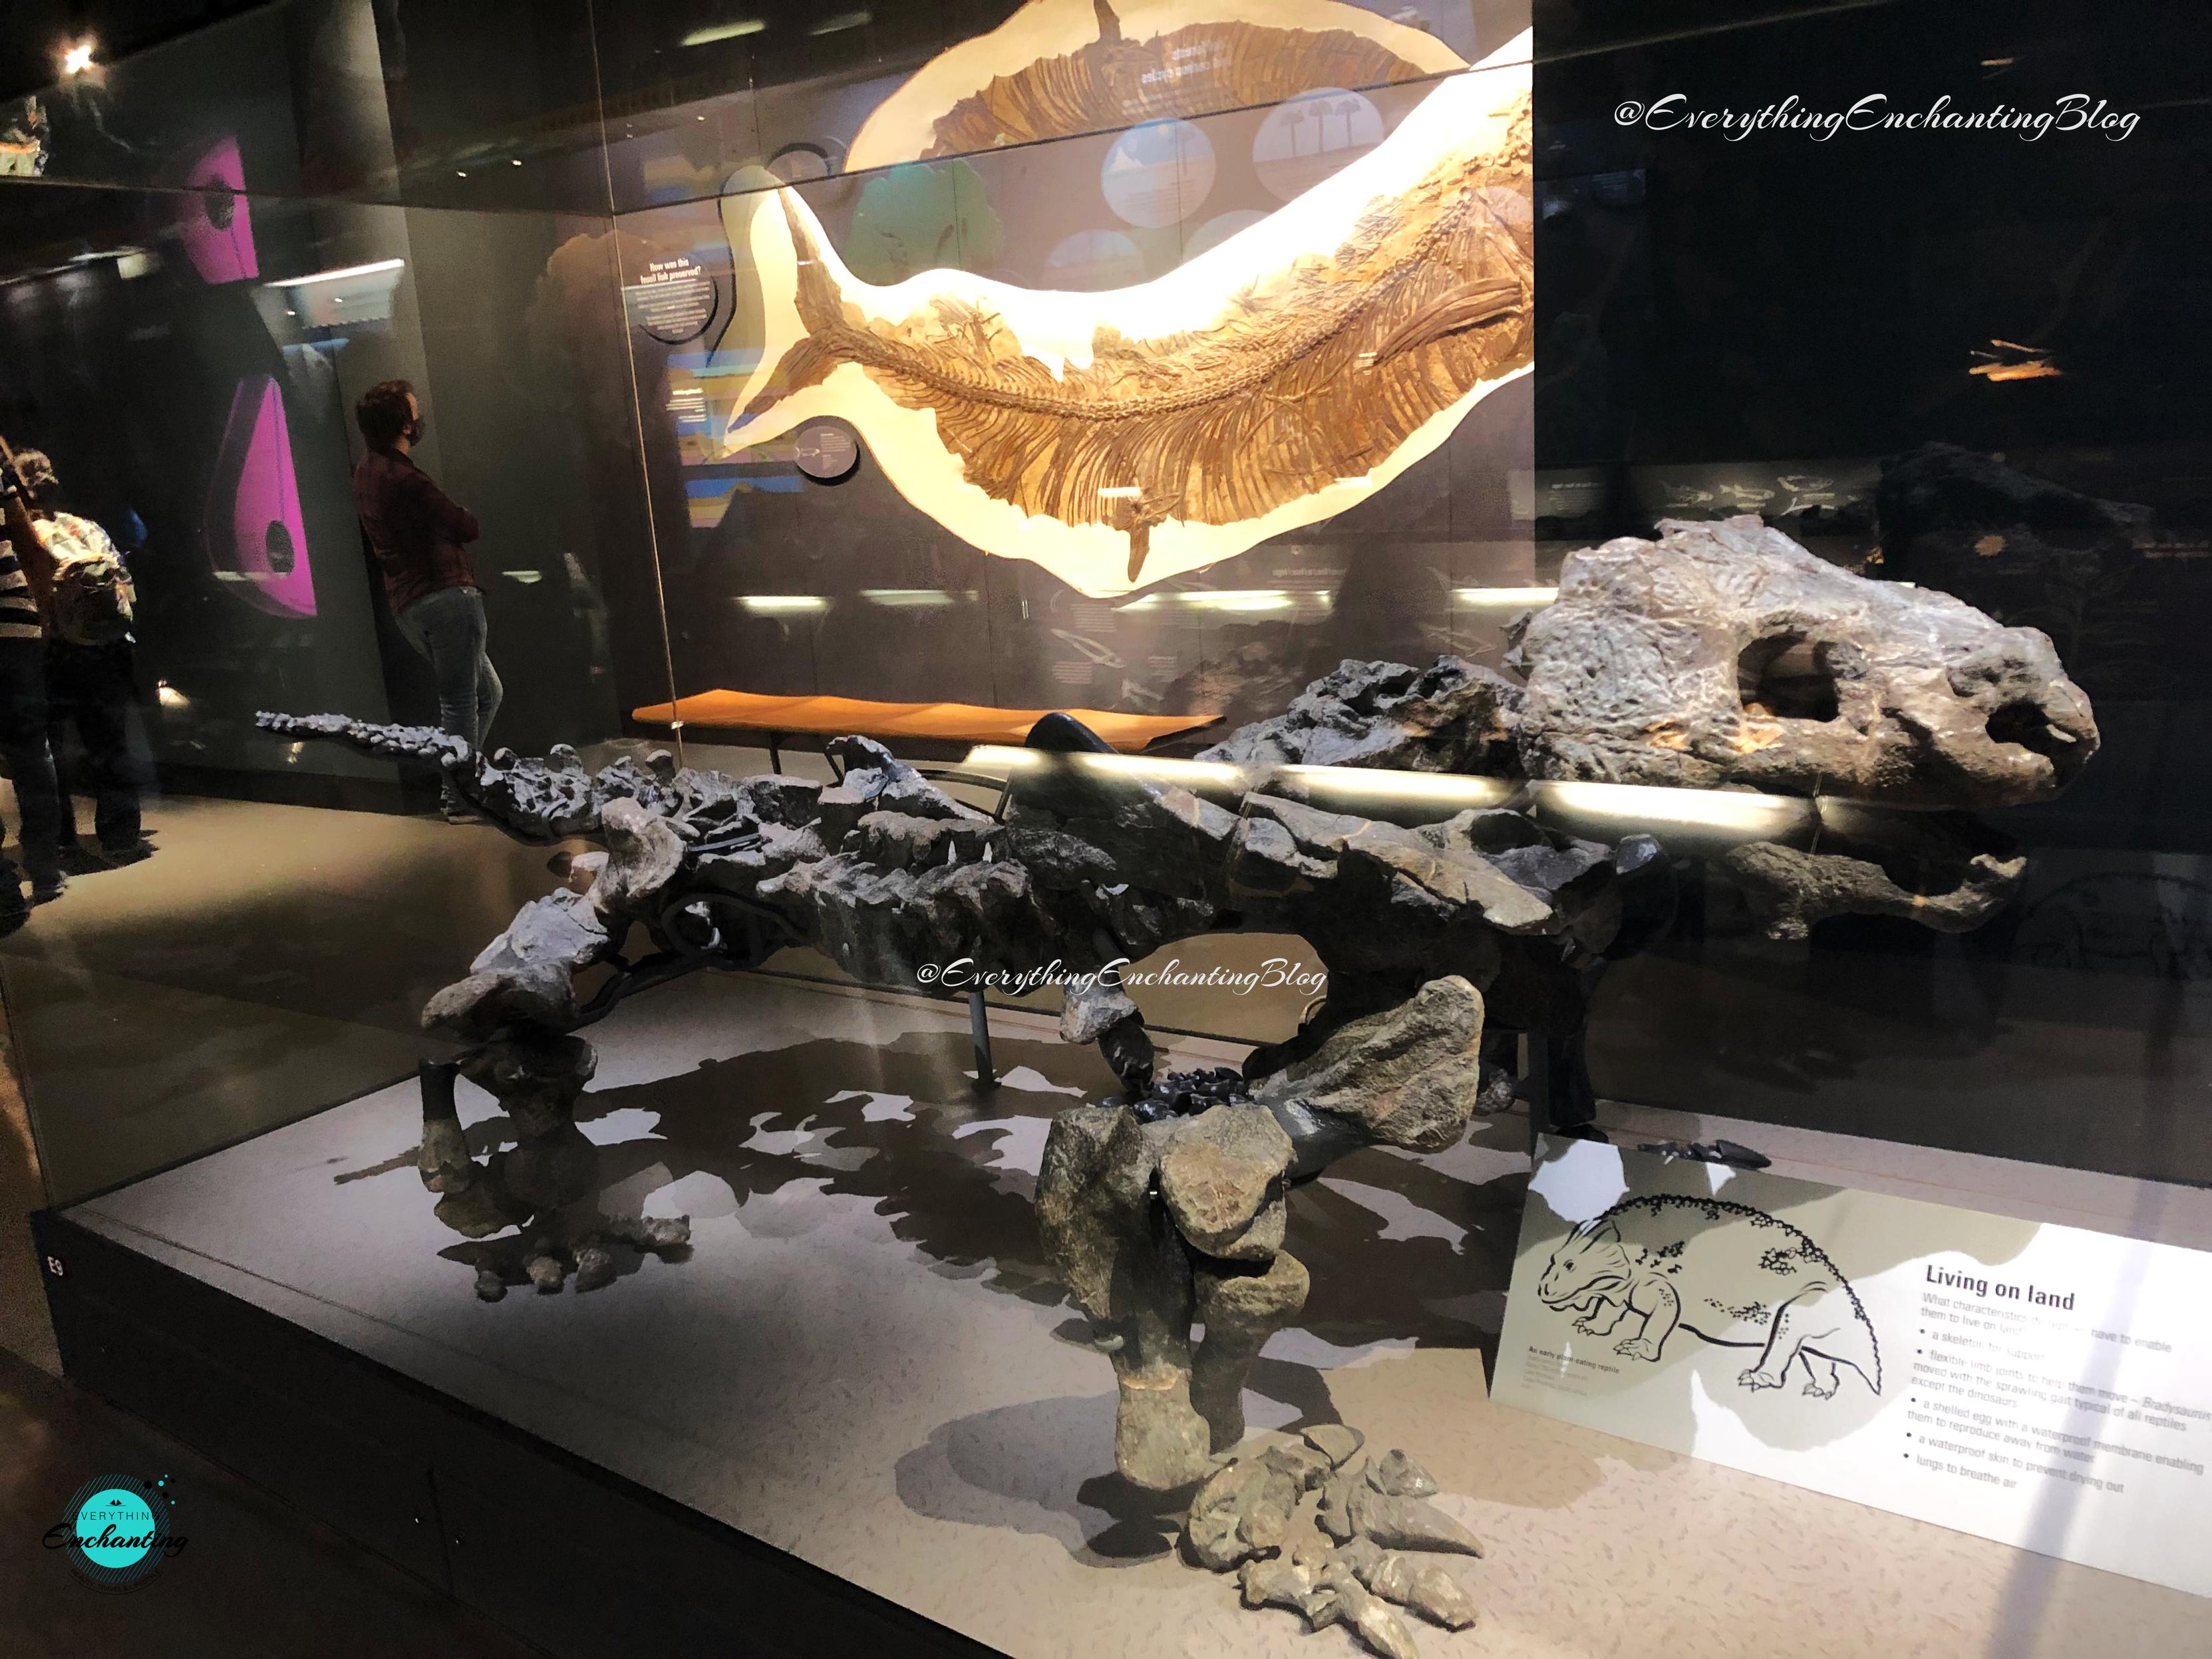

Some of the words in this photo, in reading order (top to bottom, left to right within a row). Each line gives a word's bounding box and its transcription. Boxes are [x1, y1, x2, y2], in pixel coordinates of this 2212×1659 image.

[649, 263, 663, 271] How
[678, 258, 689, 267] this
[657, 271, 669, 281] fish
[670, 266, 701, 281] preserved?
[47, 1256, 63, 1276] E9
[1926, 1264, 1988, 1298] Living
[1995, 1282, 2020, 1300] on
[2028, 1284, 2076, 1311] land
[1921, 1308, 1946, 1320] them
[1949, 1314, 1960, 1323] to
[1963, 1315, 1980, 1328] live
[1983, 1322, 1996, 1331] on
[1922, 1292, 1950, 1307] What
[1953, 1300, 2028, 1322] characteristics
[2091, 1328, 2117, 1342] have
[2120, 1334, 2131, 1345] to
[2134, 1338, 2172, 1353] enable
[1932, 1331, 1939, 1340] a
[1942, 1332, 1984, 1349] skeleton
[1529, 1346, 1538, 1354] An
[1539, 1349, 1555, 1360] early
[1557, 1353, 1597, 1370] plant-eating
[1598, 1364, 1620, 1374] reptile
[1929, 1350, 1967, 1367] flexible
[1971, 1360, 1992, 1373] limb
[1996, 1366, 2024, 1380] joints
[2028, 1374, 2038, 1382] to
[2068, 1382, 2095, 1396] them
[2098, 1389, 2128, 1403] move
[1911, 1376, 1945, 1391] except
[1948, 1384, 1965, 1396] the
[1967, 1388, 2017, 1408] dinosaurs
[1913, 1362, 1947, 1377] moved
[1950, 1370, 1973, 1382] with
[1976, 1376, 1992, 1387] the
[1996, 1381, 2048, 1400] sprawling
[2074, 1398, 2110, 1414] typical
[2113, 1407, 2124, 1417] of
[2128, 1410, 2141, 1421] all
[2144, 1414, 2187, 1432] reptiles
[1907, 1410, 1933, 1424] them
[1936, 1417, 1946, 1428] to
[1949, 1420, 2001, 1440] reproduce
[2004, 1434, 2031, 1449] away
[2036, 1441, 2060, 1454] from
[2064, 1449, 2095, 1463] water
[1923, 1400, 1930, 1409] a
[1933, 1402, 1970, 1418] shelled
[1973, 1412, 1992, 1426] egg
[1995, 1417, 2018, 1429] with
[2021, 1424, 2028, 1432] a
[2031, 1427, 2092, 1447] waterproof
[2094, 1439, 2152, 1461] membrane
[2155, 1455, 2204, 1476] enabling
[1916, 1454, 1944, 1471] lungs
[1947, 1463, 1957, 1473] to
[1960, 1466, 2000, 1485] breathe
[2002, 1478, 2016, 1489] air
[1919, 1435, 1925, 1443] a
[1929, 1437, 1986, 1458] waterproof
[1988, 1451, 2009, 1464] skin
[2013, 1457, 2023, 1468] to
[2026, 1461, 2066, 1481] prevent
[2069, 1470, 2103, 1491] drying
[2106, 1481, 2125, 1493] out
